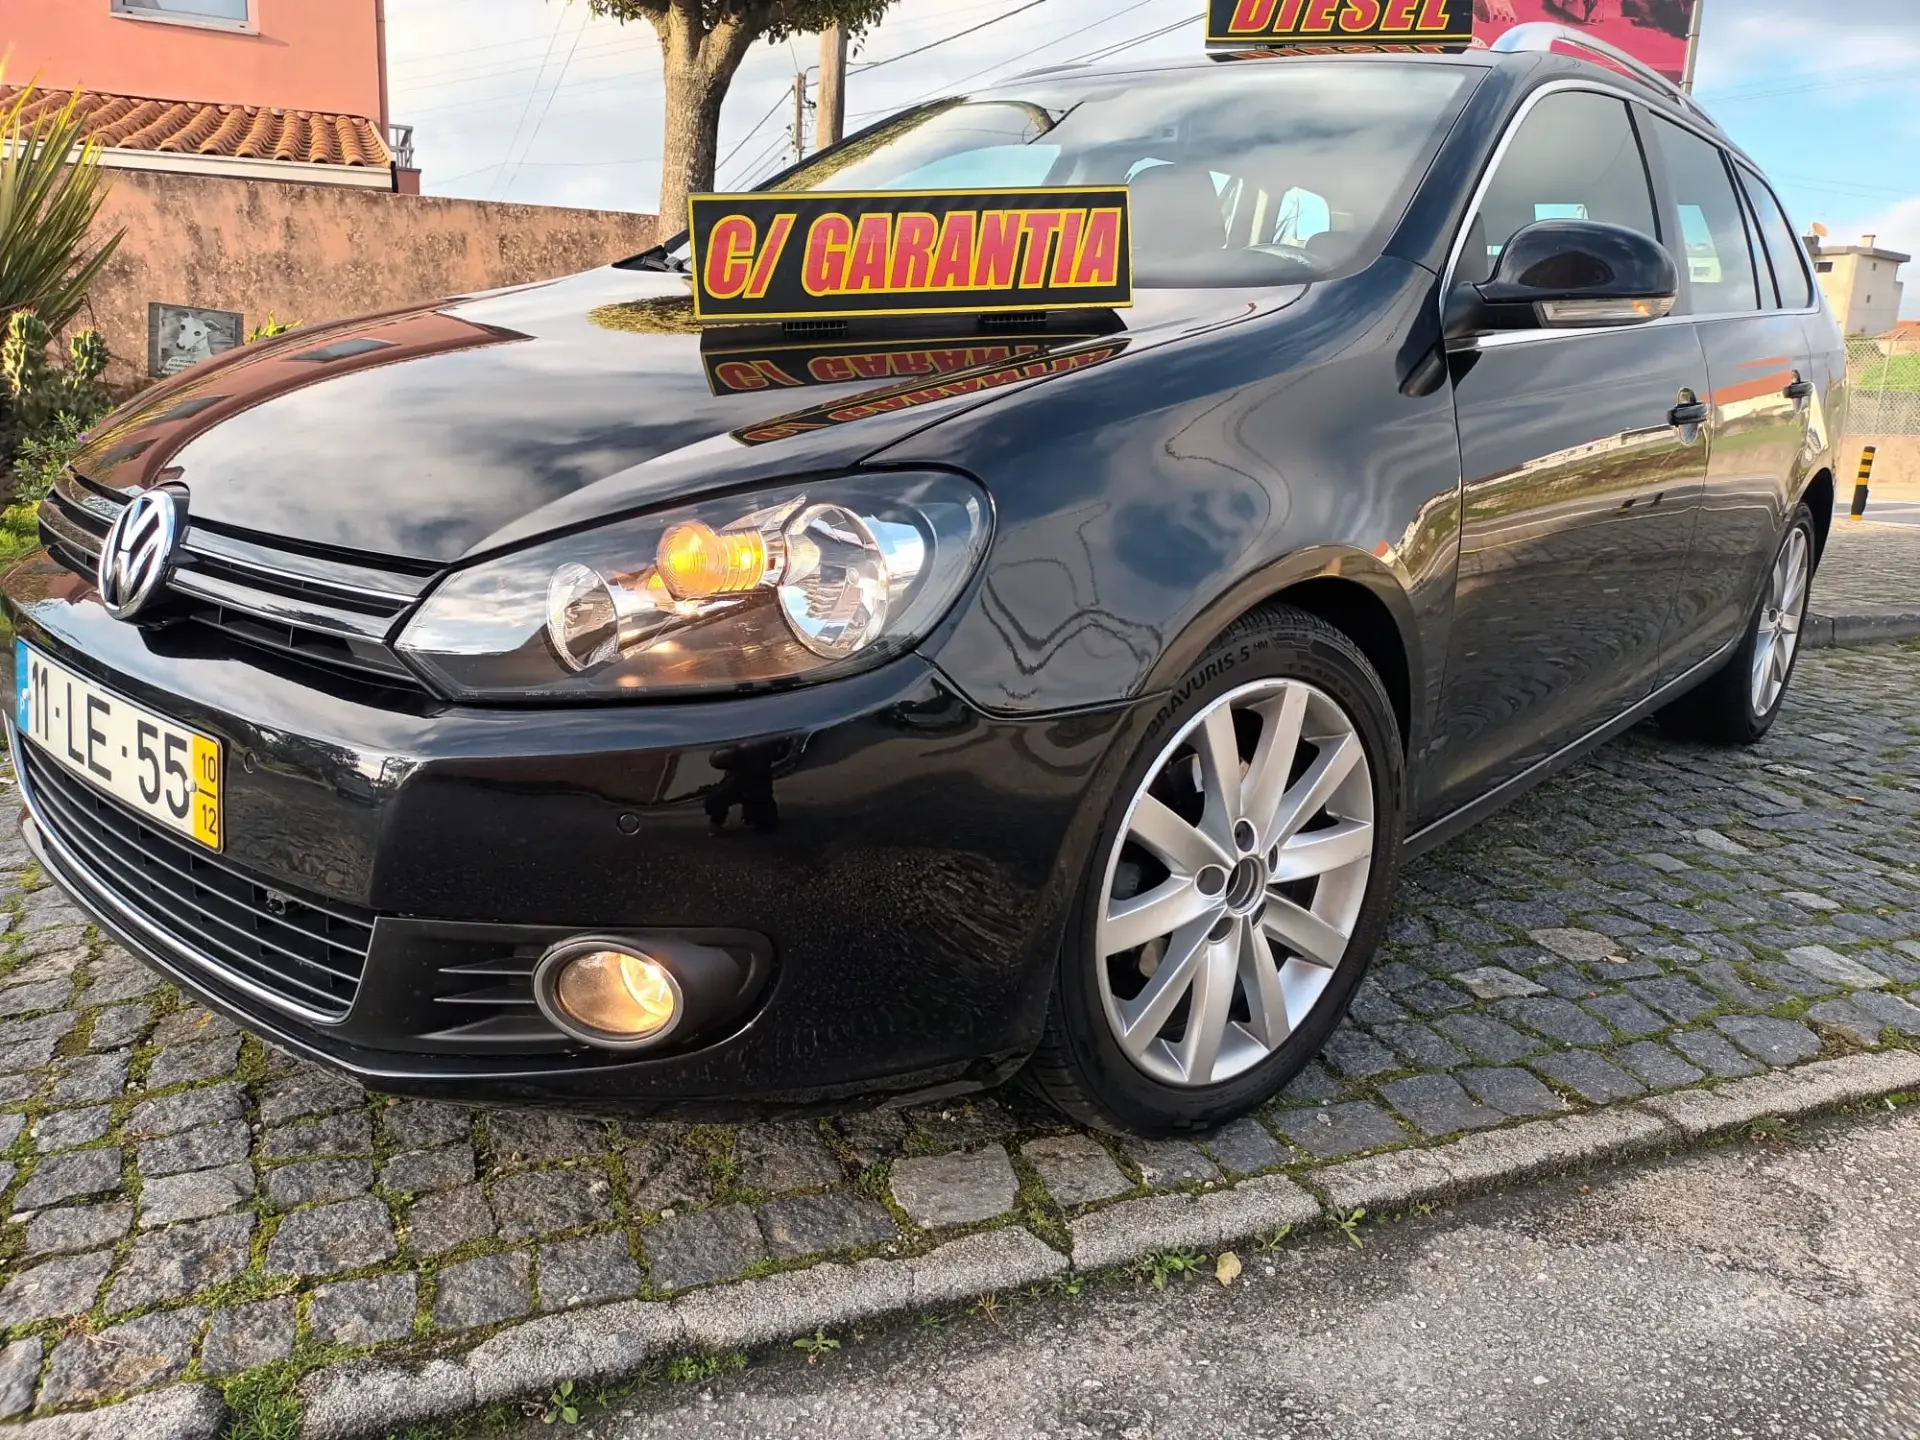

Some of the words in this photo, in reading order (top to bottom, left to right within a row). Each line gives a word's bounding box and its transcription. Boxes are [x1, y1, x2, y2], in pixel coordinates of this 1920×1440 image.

[704, 213, 797, 299] C/
[801, 208, 1123, 297] GARANTIA
[1239, 645, 1251, 662] 5
[201, 752, 217, 783] 10
[201, 804, 217, 835] 12
